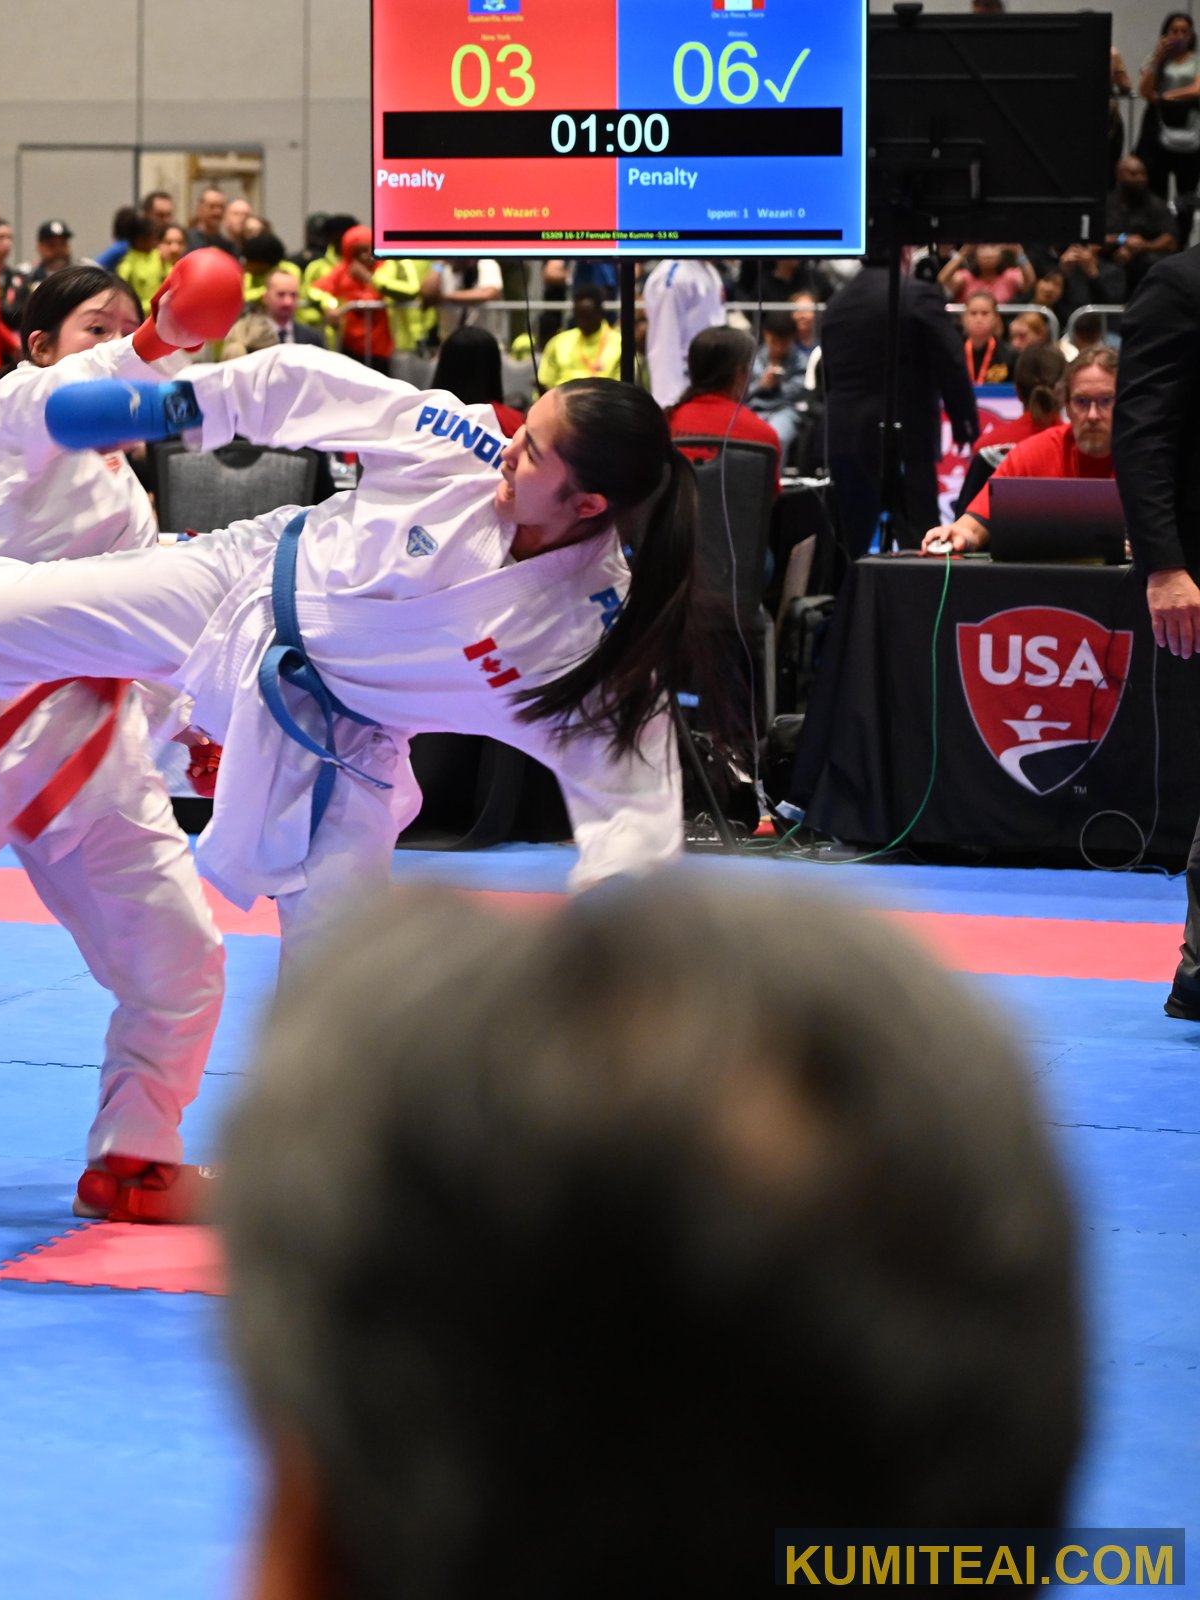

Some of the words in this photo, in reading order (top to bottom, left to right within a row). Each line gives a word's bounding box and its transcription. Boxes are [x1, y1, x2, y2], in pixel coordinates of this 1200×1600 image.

[451, 43, 536, 107] 03
[550, 113, 670, 153] 01:00
[376, 169, 445, 191] Penalty
[628, 167, 699, 189] Penalty
[453, 207, 485, 220] Ippon:
[487, 207, 496, 218] 0
[541, 207, 550, 218] 0
[706, 207, 739, 220] Ippon:
[743, 207, 749, 218] 1
[797, 207, 806, 218] 0
[585, 231, 611, 240] Female
[629, 231, 655, 240] Kumite
[978, 633, 1109, 689] USA
